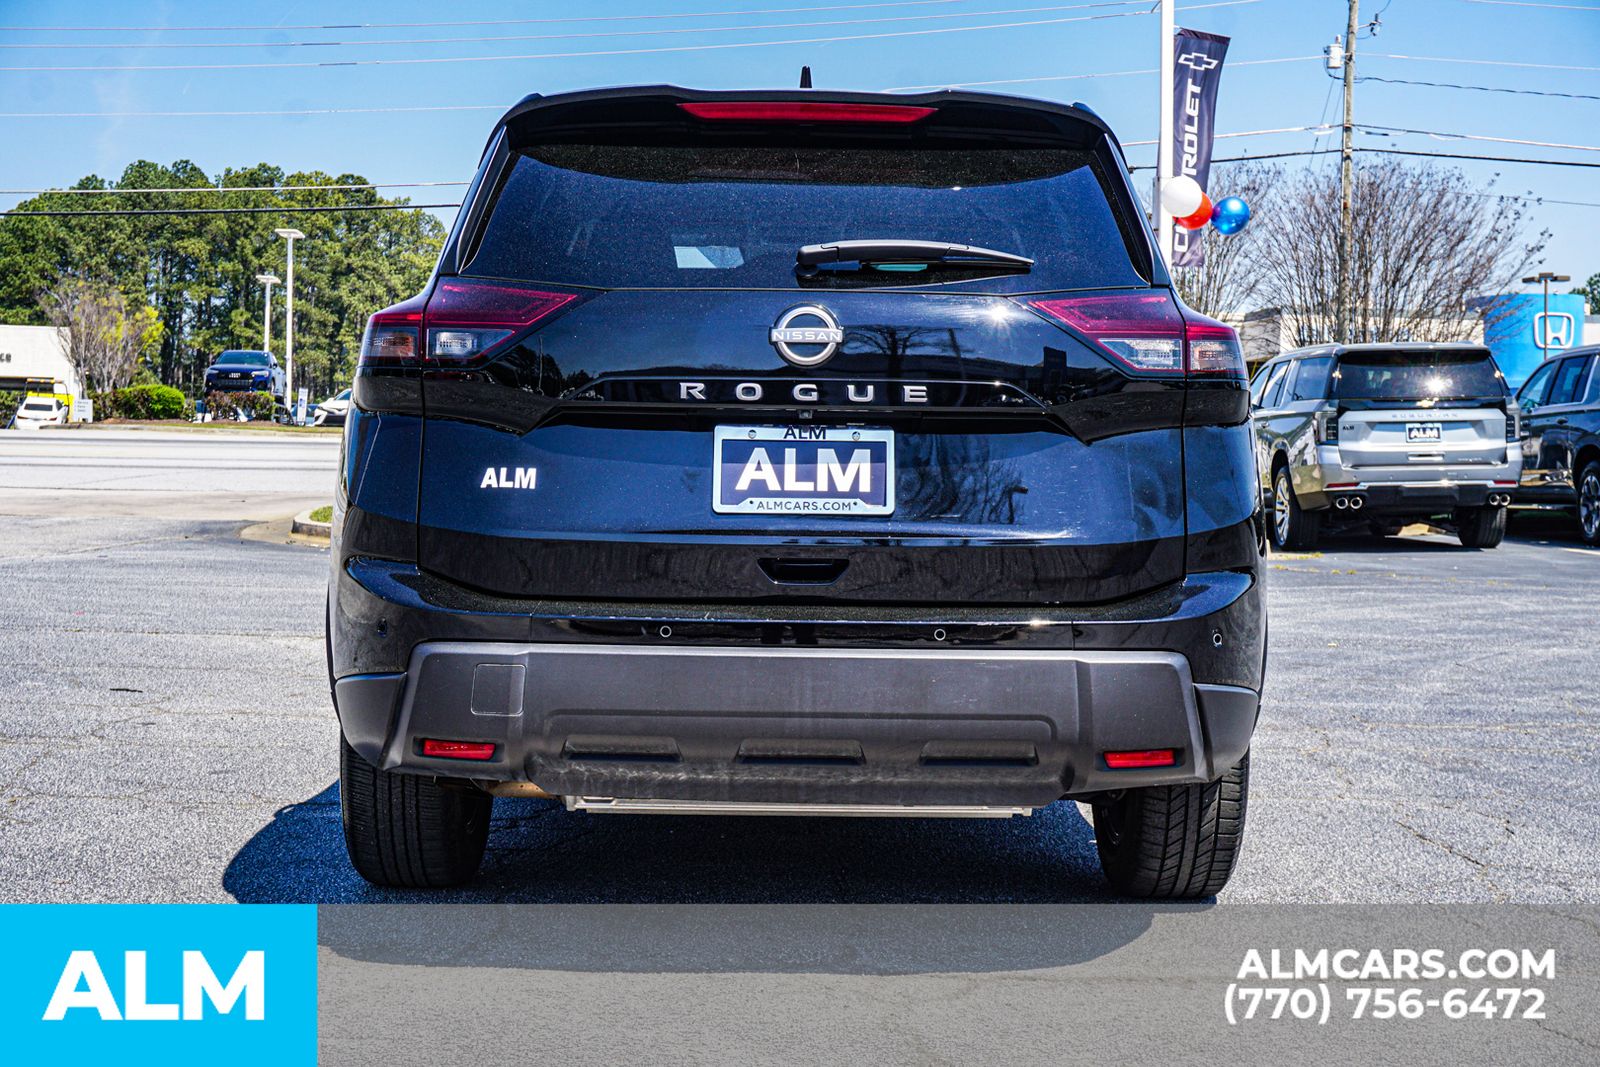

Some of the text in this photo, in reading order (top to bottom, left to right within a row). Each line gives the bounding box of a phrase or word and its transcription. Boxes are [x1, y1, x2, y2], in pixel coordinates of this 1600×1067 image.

[1174, 78, 1202, 253] CROLET
[773, 331, 843, 342] NISSAN
[679, 382, 928, 403] ROGUE
[783, 426, 827, 440] ALM
[1410, 427, 1439, 438] ALM
[480, 467, 537, 489] ALM
[735, 448, 871, 492] ALM
[756, 501, 852, 512] ALMCARS.COM
